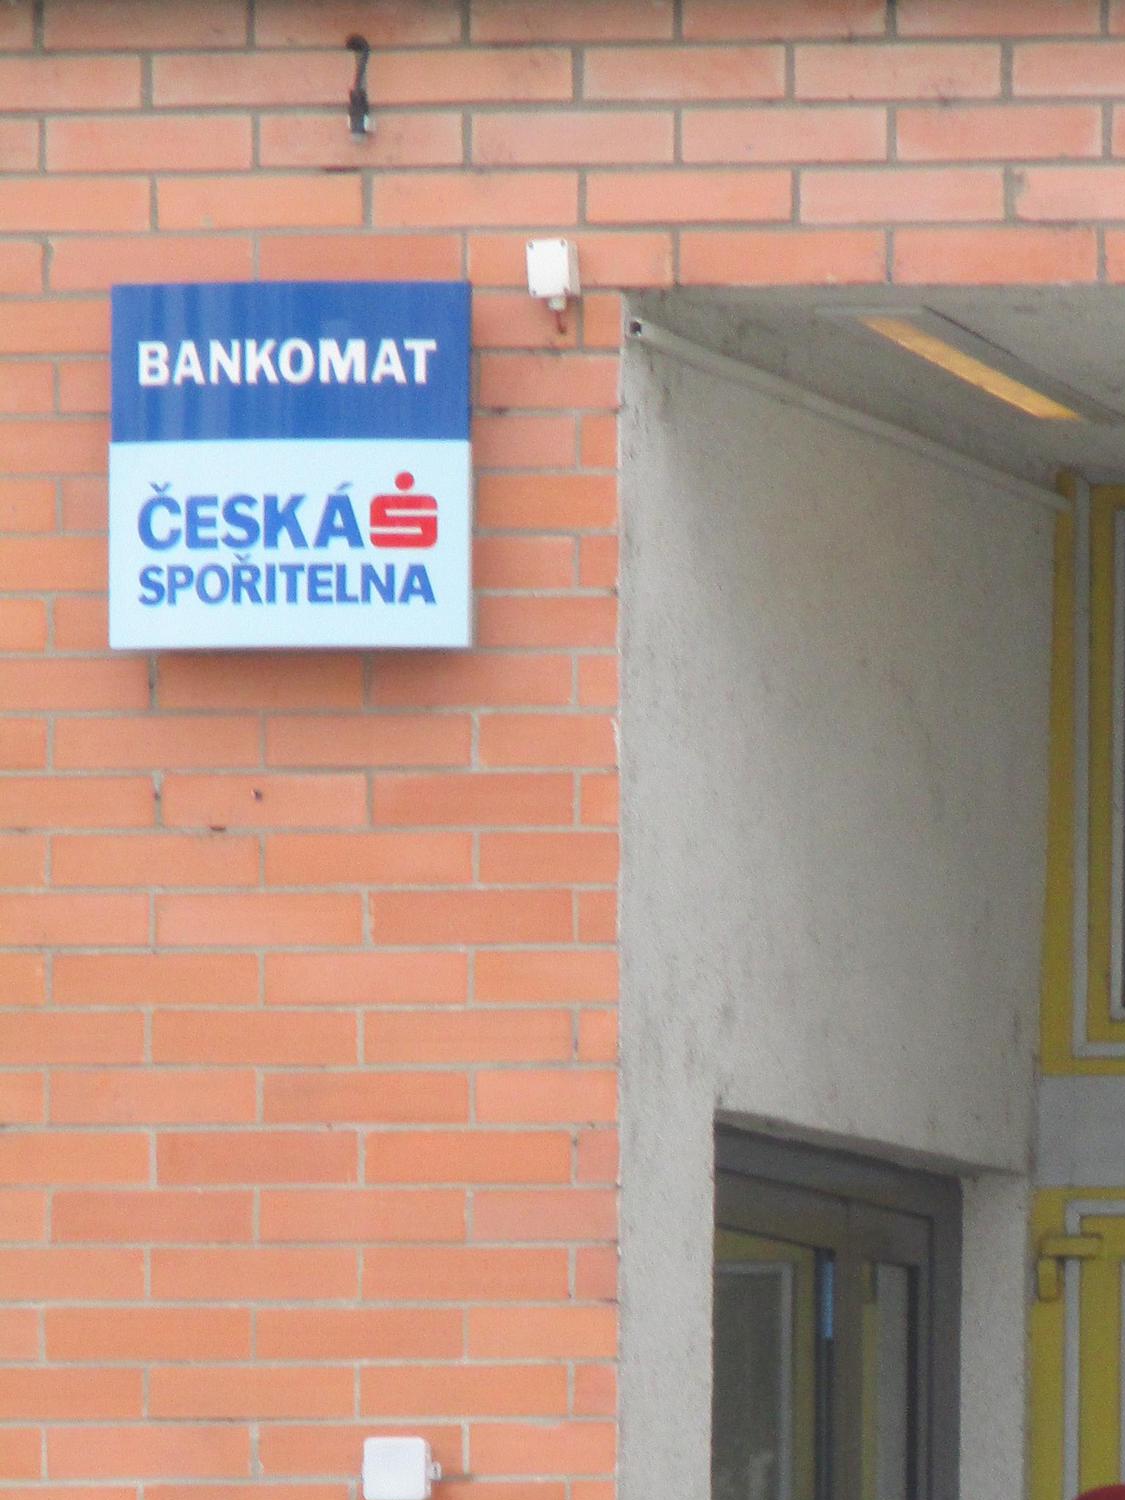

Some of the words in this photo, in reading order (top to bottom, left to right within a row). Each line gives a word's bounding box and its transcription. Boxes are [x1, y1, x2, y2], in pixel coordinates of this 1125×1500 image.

[137, 337, 438, 387] BANKOMAT
[137, 481, 365, 551] ČESKÁ
[138, 553, 438, 606] SPOŘITELNA
